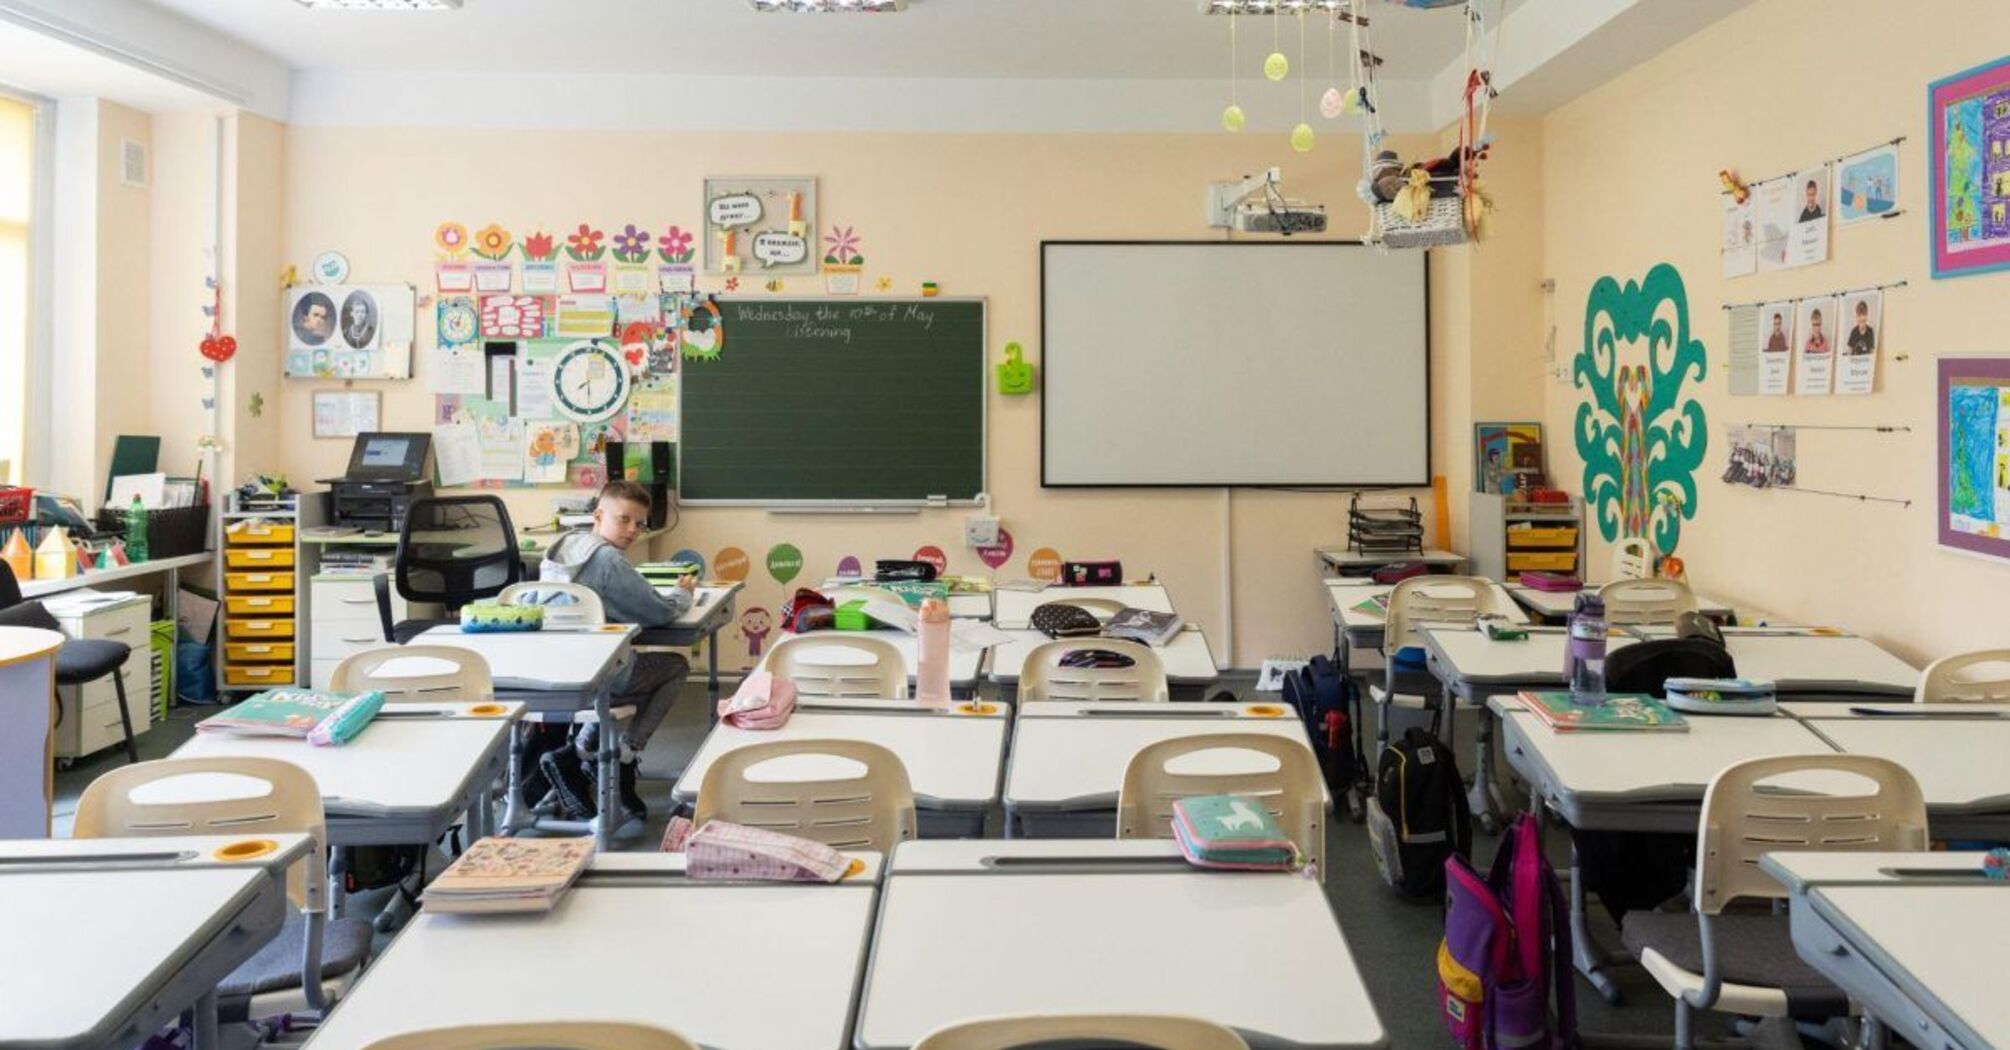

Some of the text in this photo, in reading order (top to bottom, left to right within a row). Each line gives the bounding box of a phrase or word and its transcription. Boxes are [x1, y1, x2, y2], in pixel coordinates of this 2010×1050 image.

[736, 303, 811, 329] Wednesday
[815, 303, 840, 321] the
[879, 304, 897, 321] of
[903, 303, 935, 330] May
[785, 323, 852, 345] Listening
